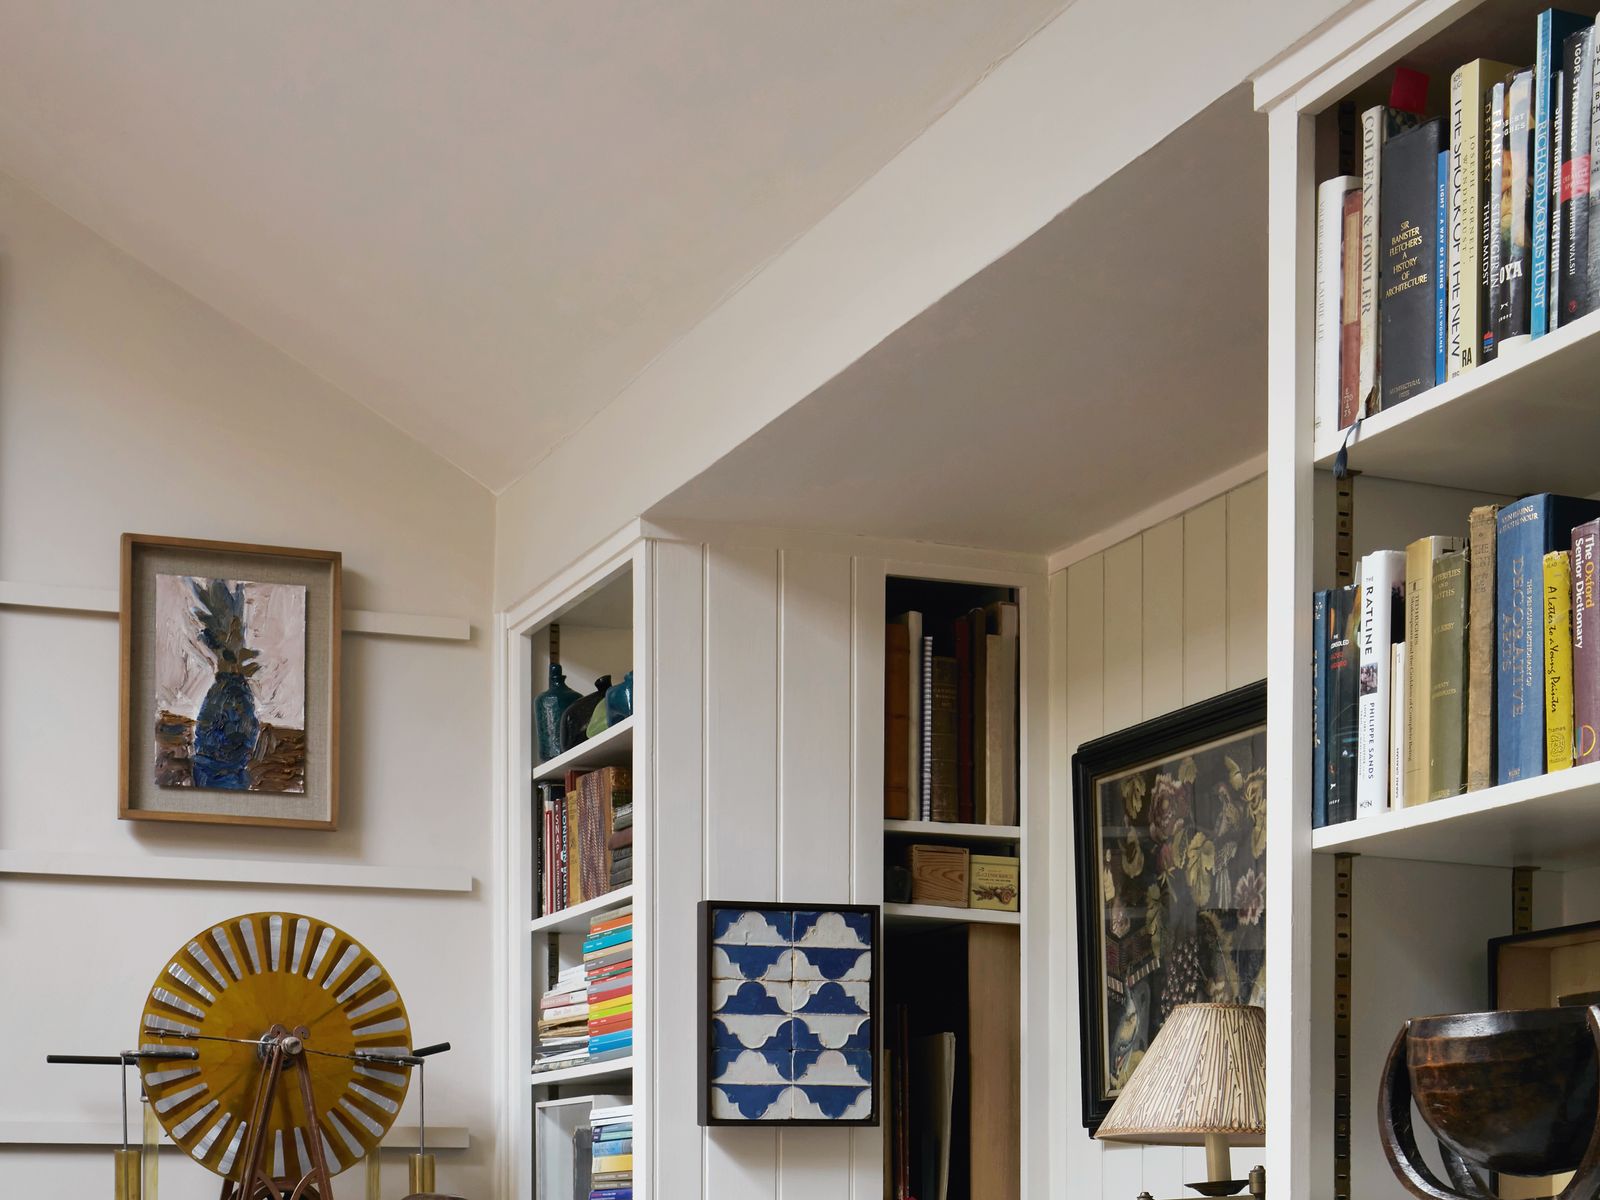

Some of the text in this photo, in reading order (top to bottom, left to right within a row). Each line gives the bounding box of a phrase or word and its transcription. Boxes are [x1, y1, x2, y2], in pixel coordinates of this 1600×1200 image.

[1570, 43, 1582, 153] IGOR STRAVINSKY
[1484, 102, 1492, 182] DELANEY
[1491, 109, 1502, 169] FRANK
[1536, 121, 1548, 196] RICHARD
[1361, 115, 1375, 320] COLEFAX & FOWLER
[1400, 220, 1410, 232] SIR
[1482, 200, 1490, 243] THEIR
[1535, 200, 1545, 258] MORRIS
[1389, 235, 1423, 257] FLETCHER'S
[1391, 226, 1420, 246] BANISTER
[1439, 246, 1444, 256] OF
[1490, 202, 1500, 273] STRANGER
[1393, 256, 1418, 275] HISTORY
[1402, 251, 1408, 260] A
[1499, 260, 1523, 284] OYA
[1385, 273, 1428, 300] ARCHITECTURE
[1401, 270, 1410, 281] OF
[1490, 273, 1499, 288] IN
[1534, 259, 1545, 308] HUNT
[1462, 347, 1472, 368] RA
[1584, 533, 1595, 609] The Oxford
[1547, 586, 1558, 594] A
[1573, 538, 1584, 649] Senior Dictionary
[1364, 586, 1374, 656] RATLINE
[1547, 597, 1558, 625] Letter
[1502, 613, 1512, 672] ARTS
[1512, 556, 1525, 718] DECORATIVE
[1548, 625, 1557, 636] to
[1547, 645, 1559, 676] Young
[1550, 676, 1561, 713] Painter
